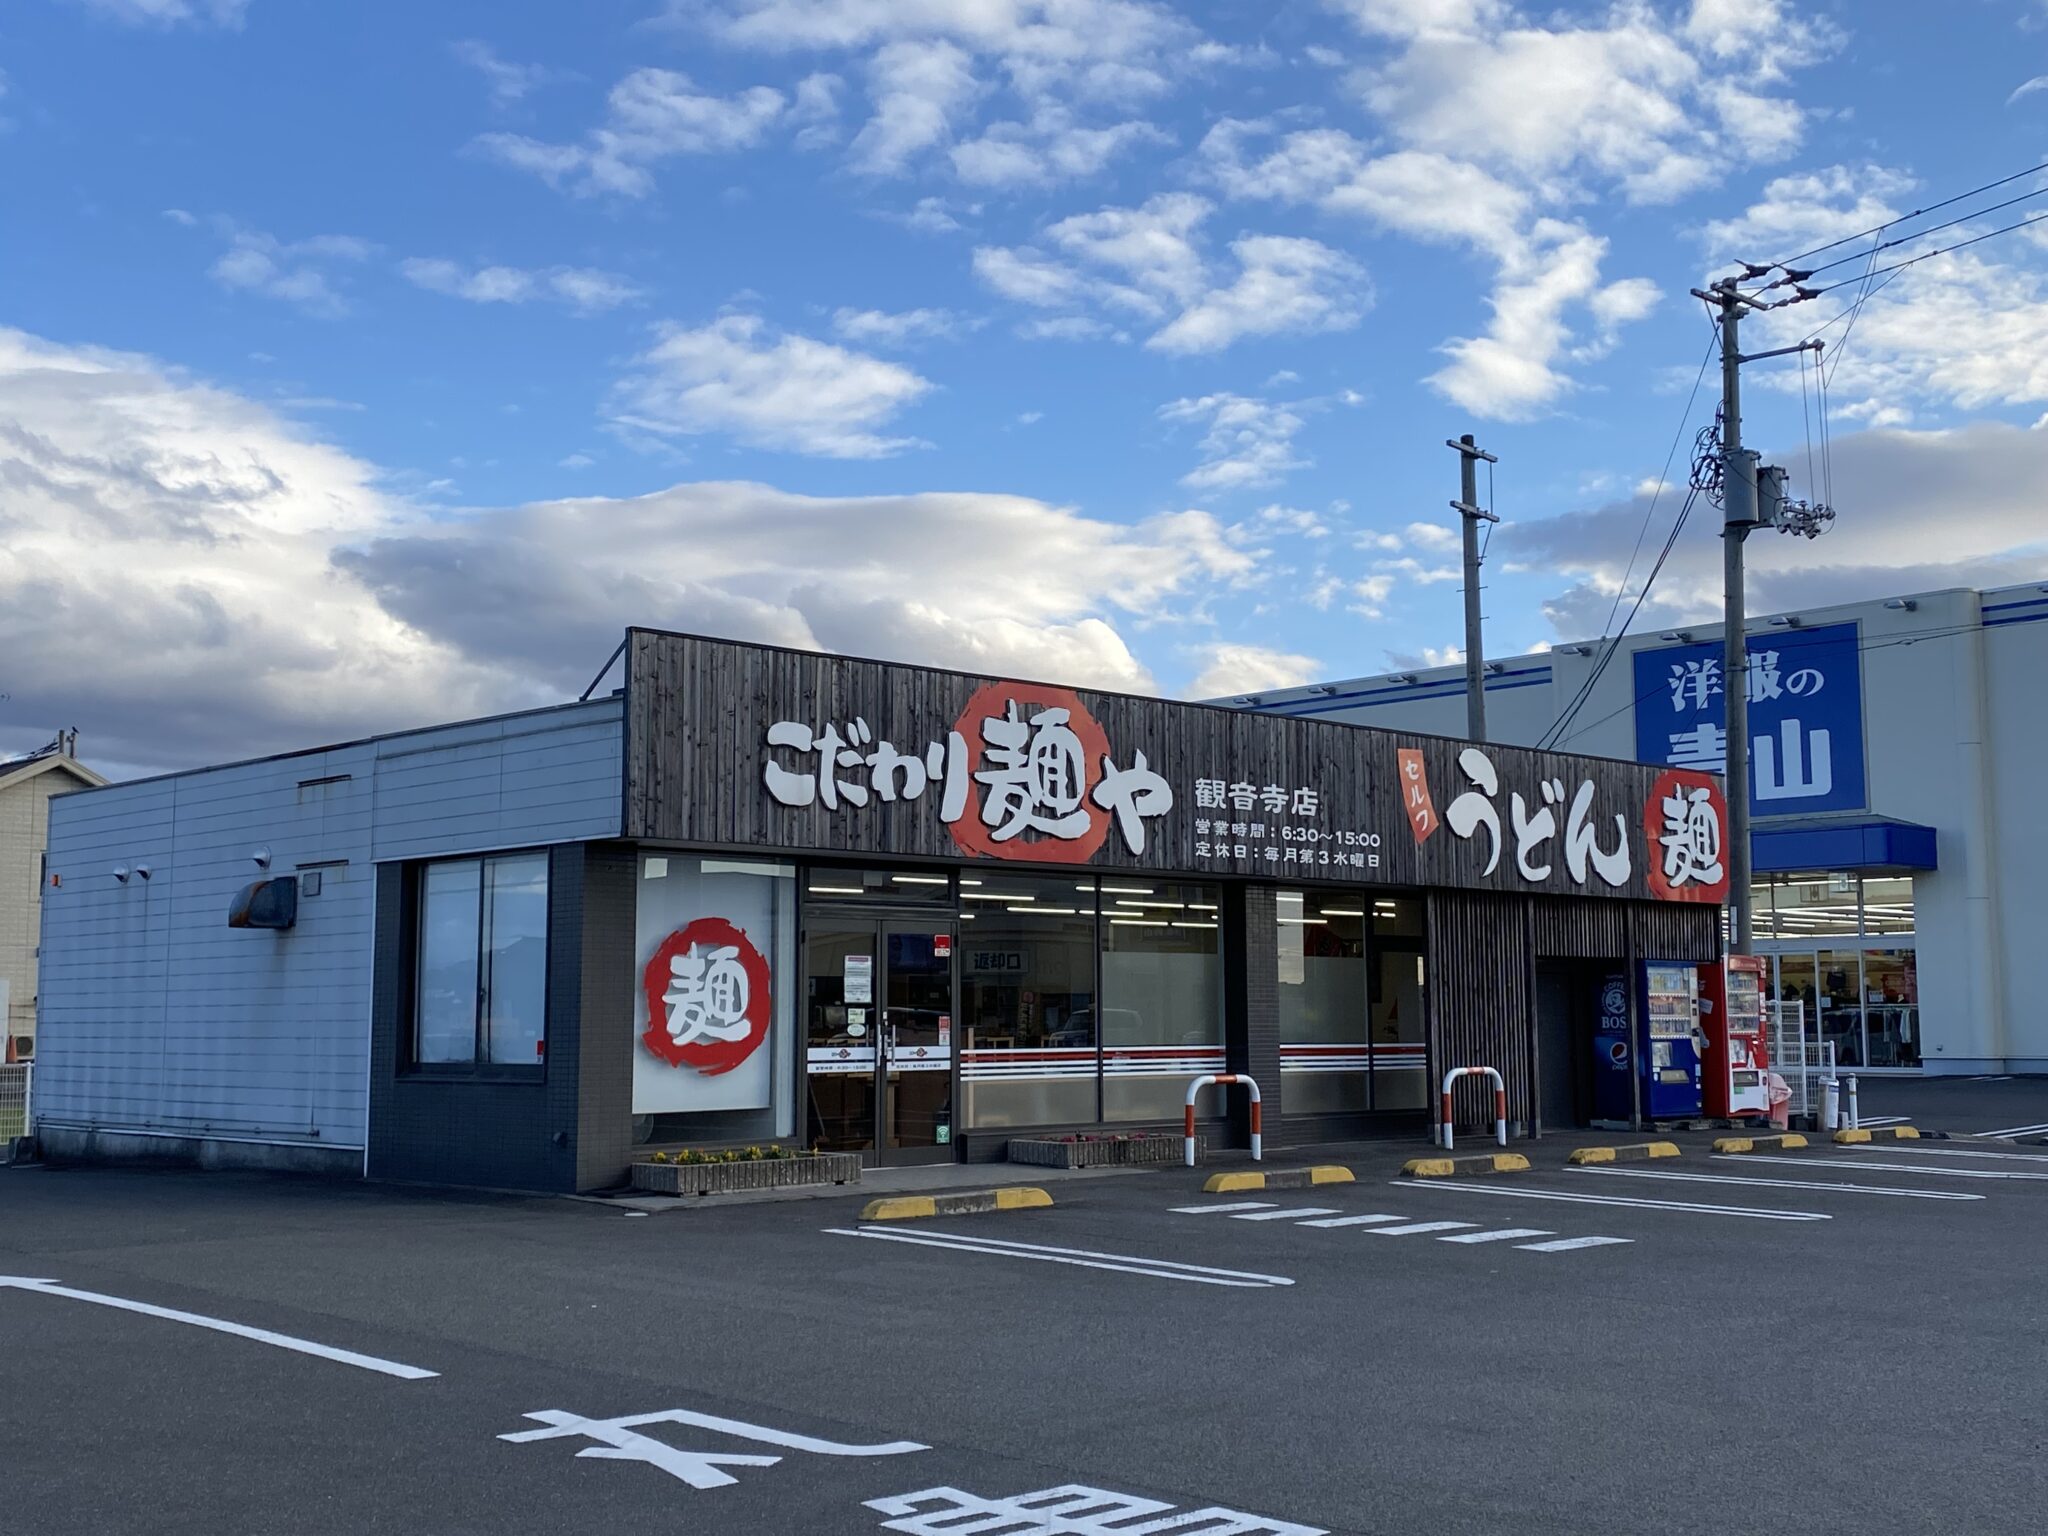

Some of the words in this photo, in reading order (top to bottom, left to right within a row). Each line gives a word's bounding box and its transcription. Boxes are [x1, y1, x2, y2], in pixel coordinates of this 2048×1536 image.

[764, 698, 1174, 856] こだわり麺や
[1195, 777, 1319, 817] 観音寺店
[1404, 758, 1430, 832] セルフ
[1446, 748, 1632, 887] うどん
[1660, 781, 1724, 888] 麺
[662, 940, 752, 1046] 麺
[974, 952, 1022, 970] 返却口
